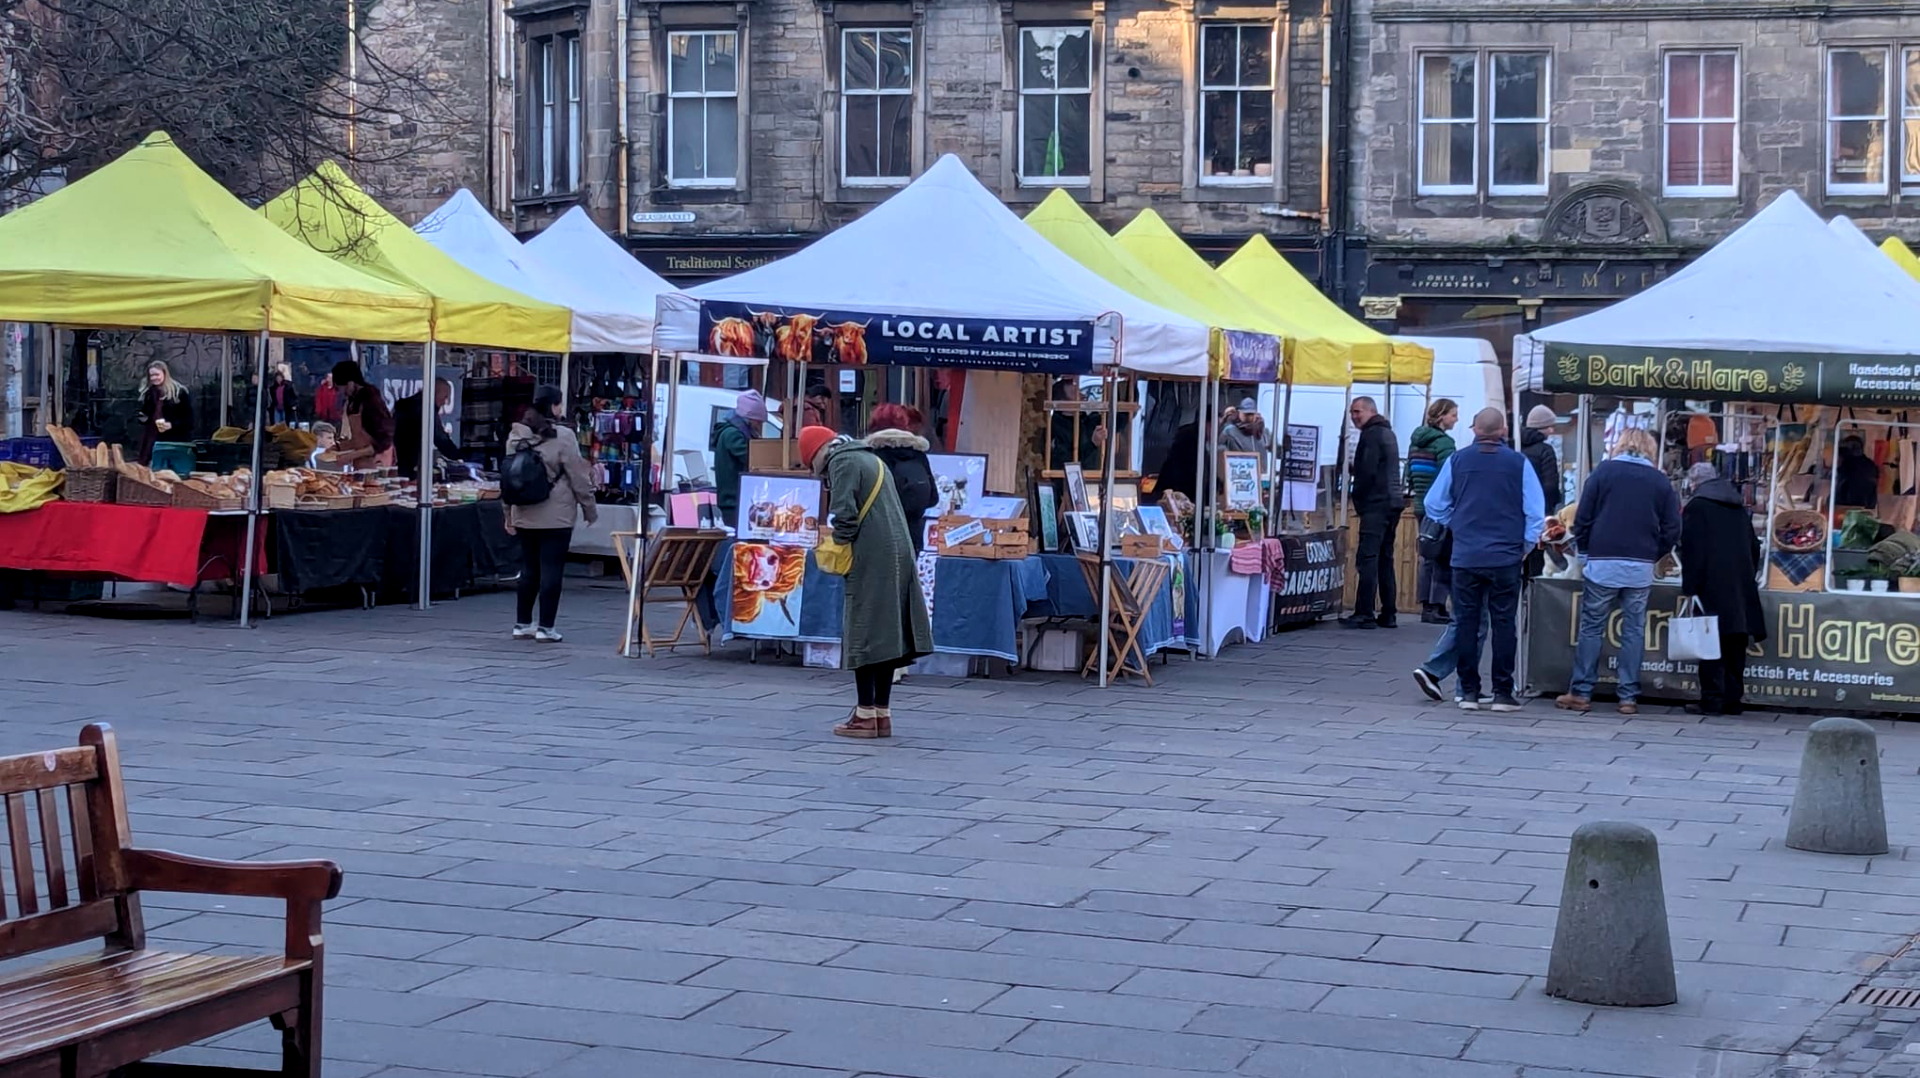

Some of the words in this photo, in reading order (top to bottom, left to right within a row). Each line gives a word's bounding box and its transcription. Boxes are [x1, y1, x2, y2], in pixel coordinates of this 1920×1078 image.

[666, 256, 731, 269] Traditional
[881, 319, 971, 341] LOCAL
[982, 325, 1083, 346] ARTIST
[1848, 362, 1912, 377] Handmade
[1280, 567, 1330, 596] SAUSAGE
[1787, 667, 1810, 681] Pet
[1813, 669, 1895, 687] Accessories
